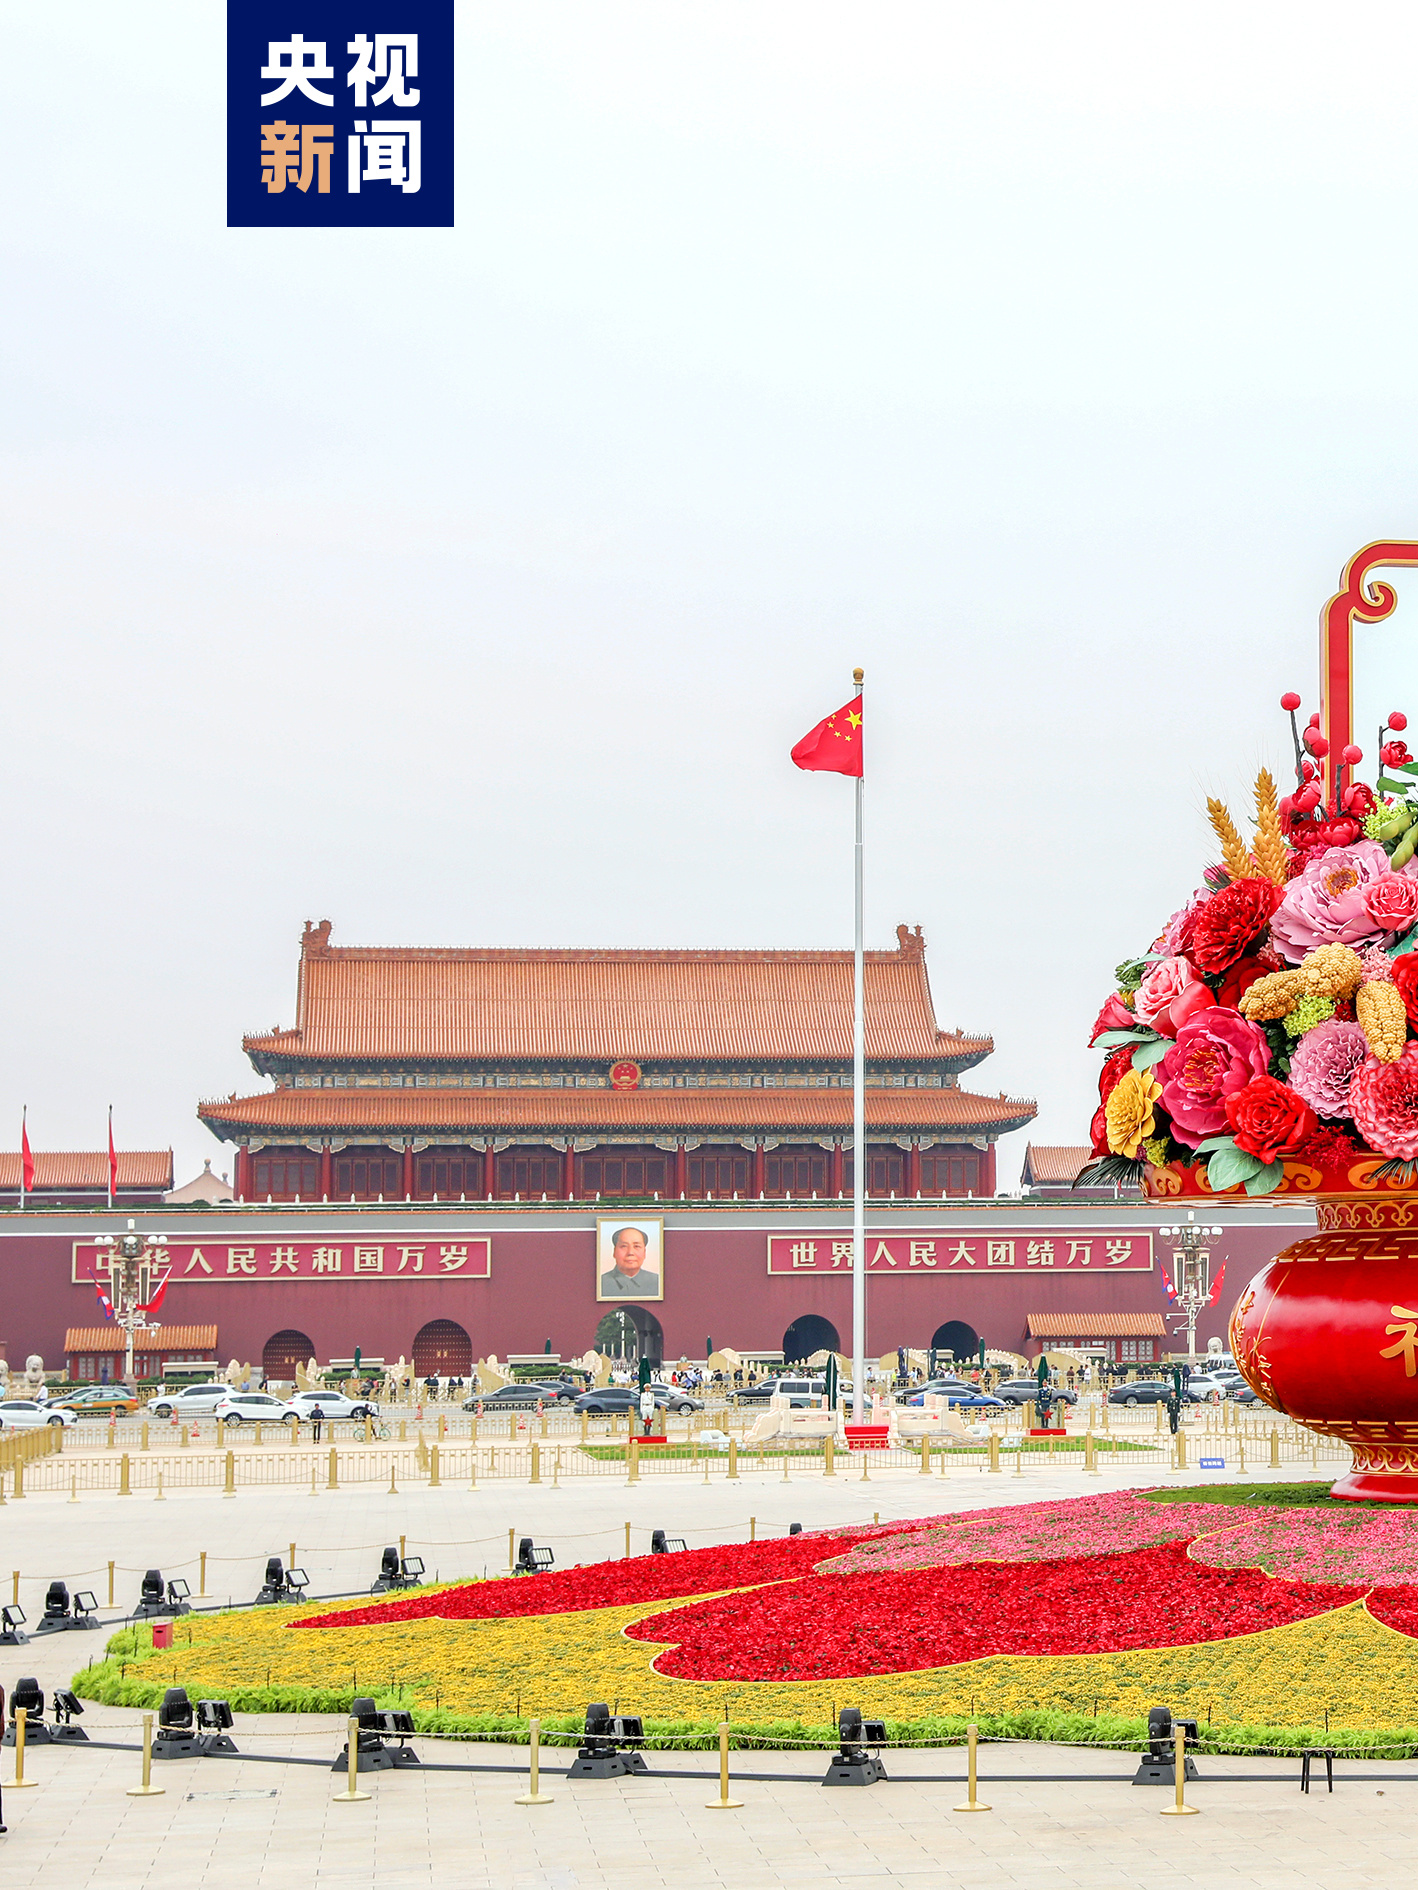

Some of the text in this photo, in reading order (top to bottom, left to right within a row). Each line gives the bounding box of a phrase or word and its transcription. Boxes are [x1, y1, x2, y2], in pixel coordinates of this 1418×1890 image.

[790, 1239, 1133, 1268] 世界人民大团结万岁
